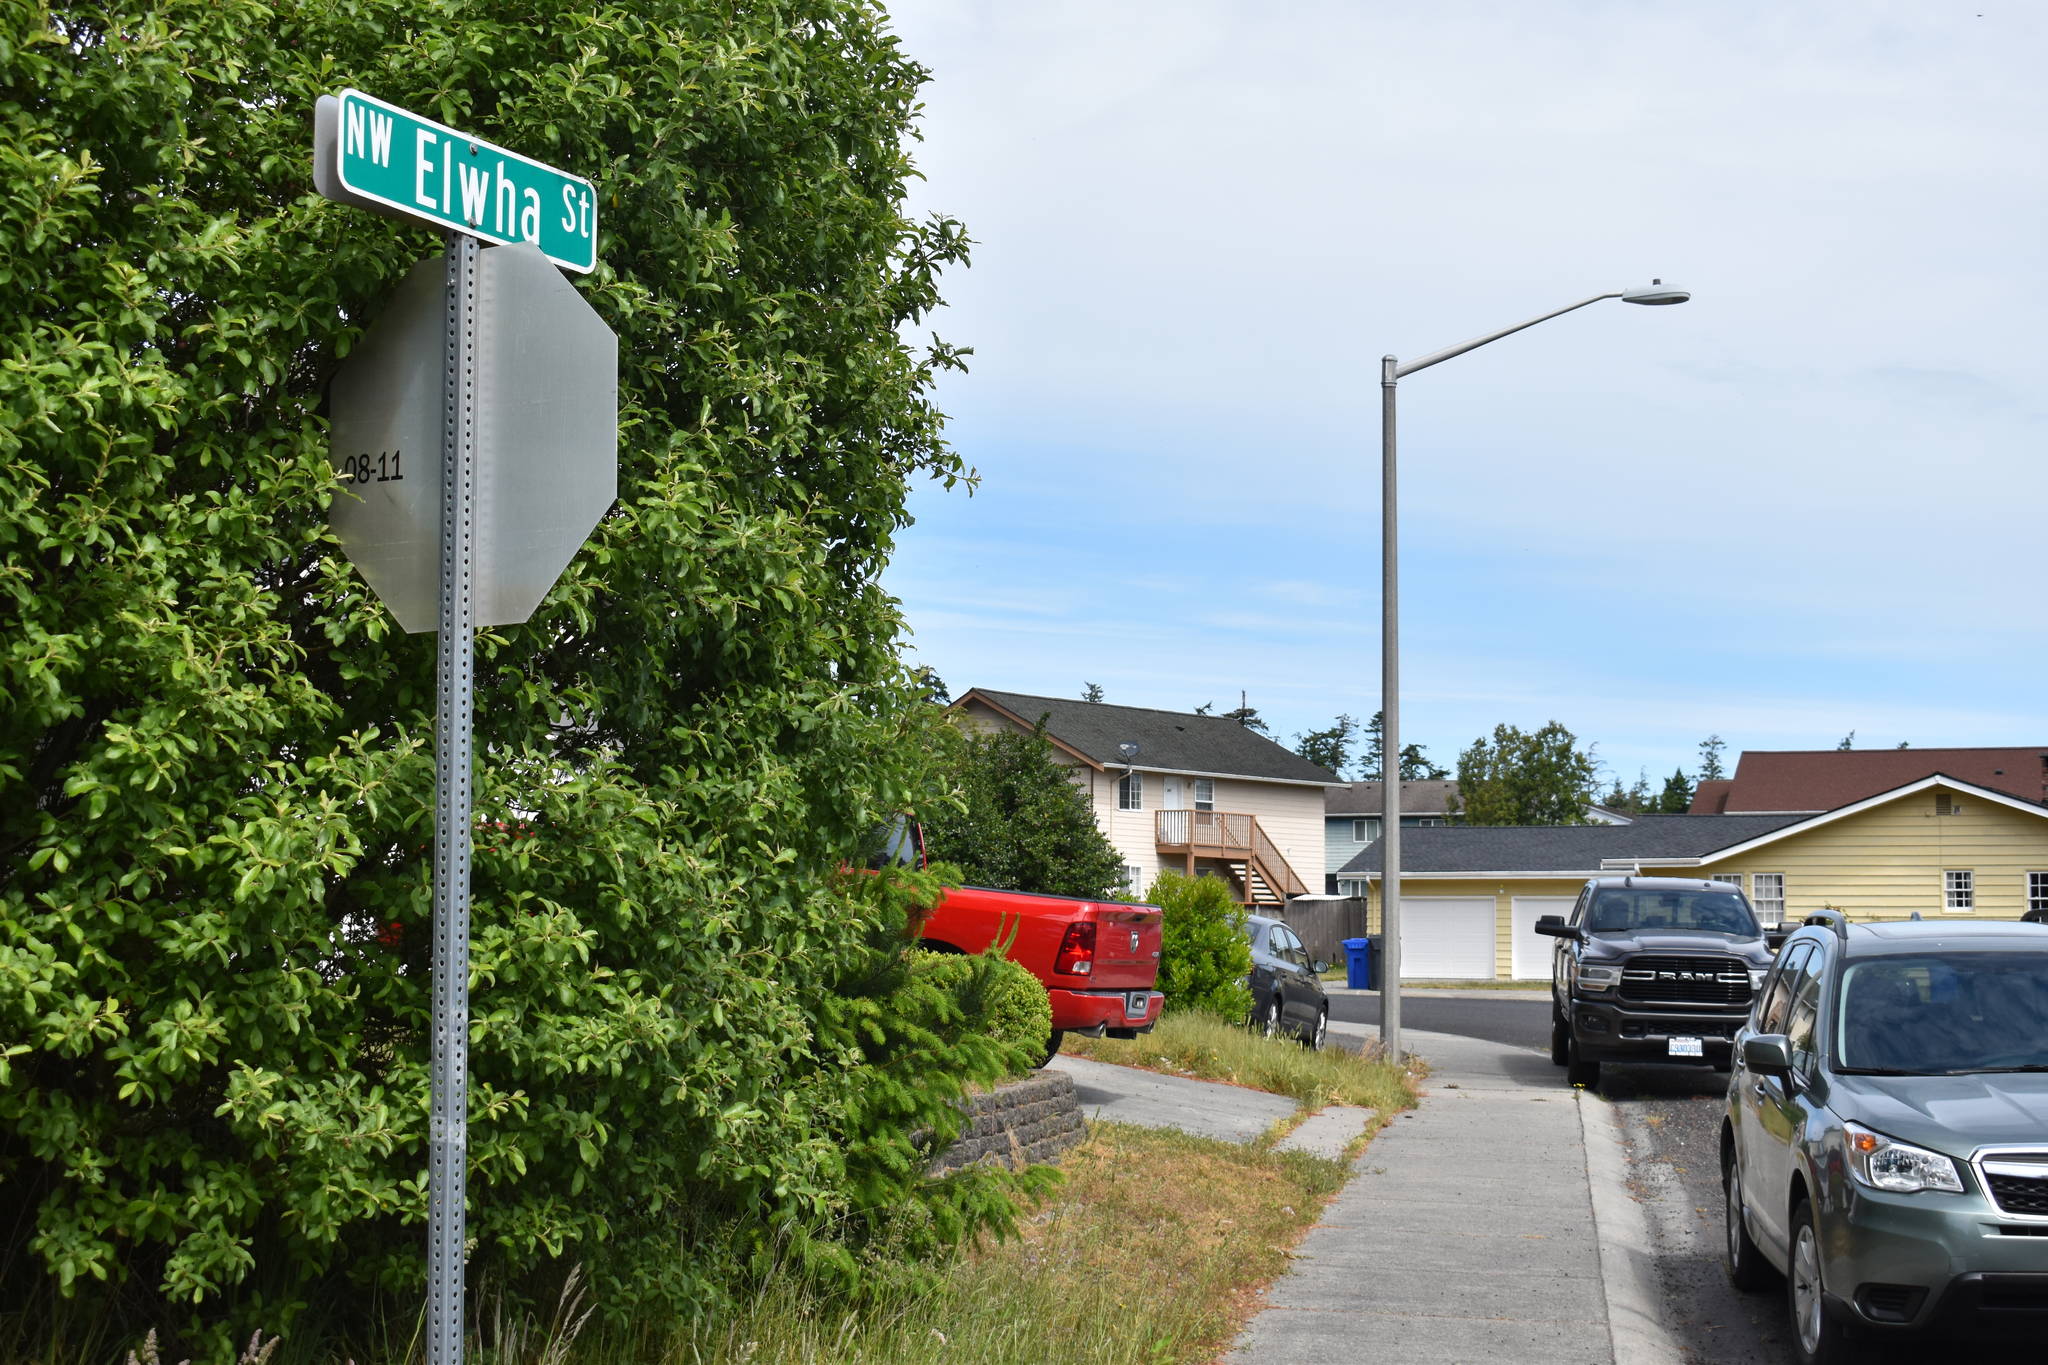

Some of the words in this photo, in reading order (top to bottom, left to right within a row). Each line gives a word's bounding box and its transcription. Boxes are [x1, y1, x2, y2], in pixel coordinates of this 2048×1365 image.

[347, 101, 393, 168] NW
[415, 128, 541, 246] Elwha
[561, 183, 590, 238] St
[345, 449, 403, 484] 08-11
[1659, 971, 1713, 981] RAM
